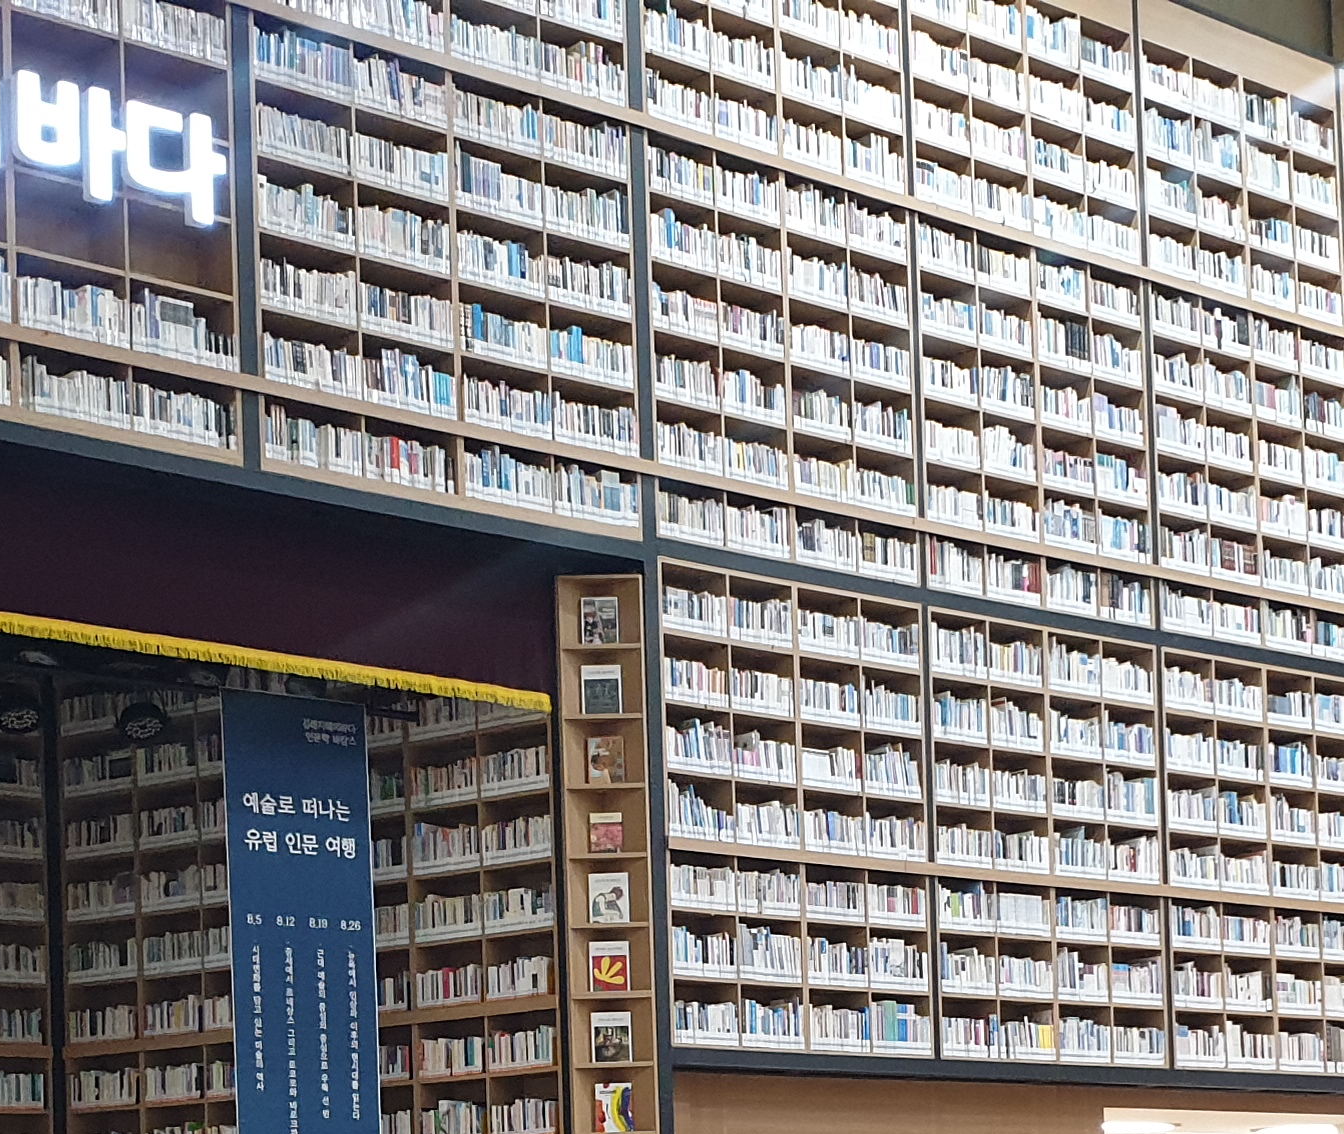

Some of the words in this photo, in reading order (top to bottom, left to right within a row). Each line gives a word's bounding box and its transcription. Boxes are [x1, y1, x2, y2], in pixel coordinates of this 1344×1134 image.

[243, 792, 296, 815] 예술로
[302, 798, 351, 822] 떠나는
[244, 828, 277, 852] 유럽
[285, 833, 318, 856] 인문
[325, 836, 356, 859] 여행
[247, 914, 262, 925] 8.5
[276, 915, 296, 927] 8.12
[340, 920, 361, 931] 8.26
